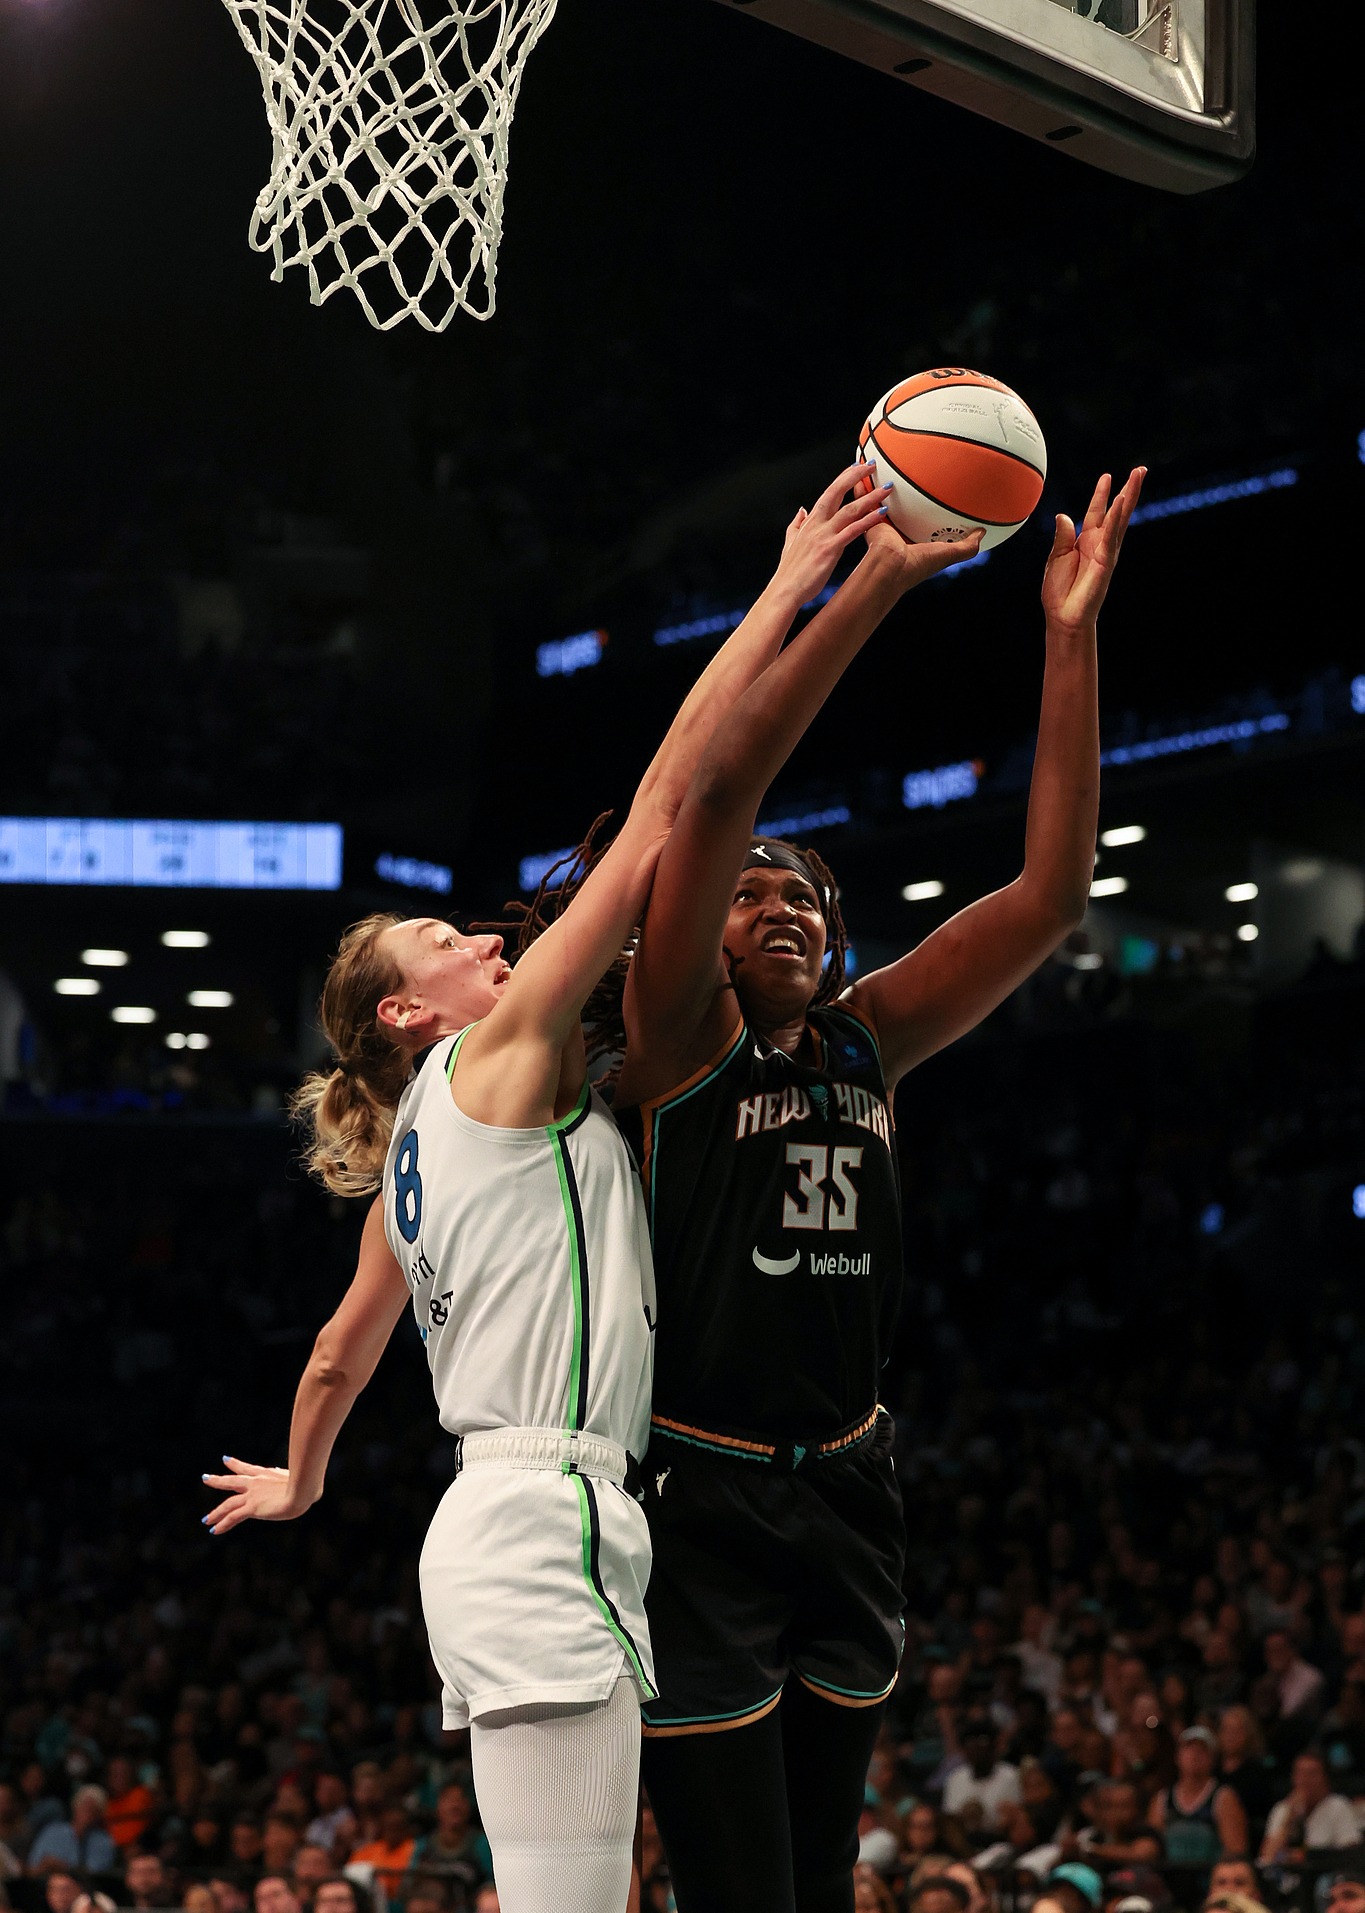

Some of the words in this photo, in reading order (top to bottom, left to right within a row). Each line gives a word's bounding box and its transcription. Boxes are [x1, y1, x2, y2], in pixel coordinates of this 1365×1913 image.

[735, 1085, 812, 1141] NEW
[394, 1129, 422, 1244] 8
[782, 1143, 864, 1231] 35
[810, 1252, 871, 1276] Webull
